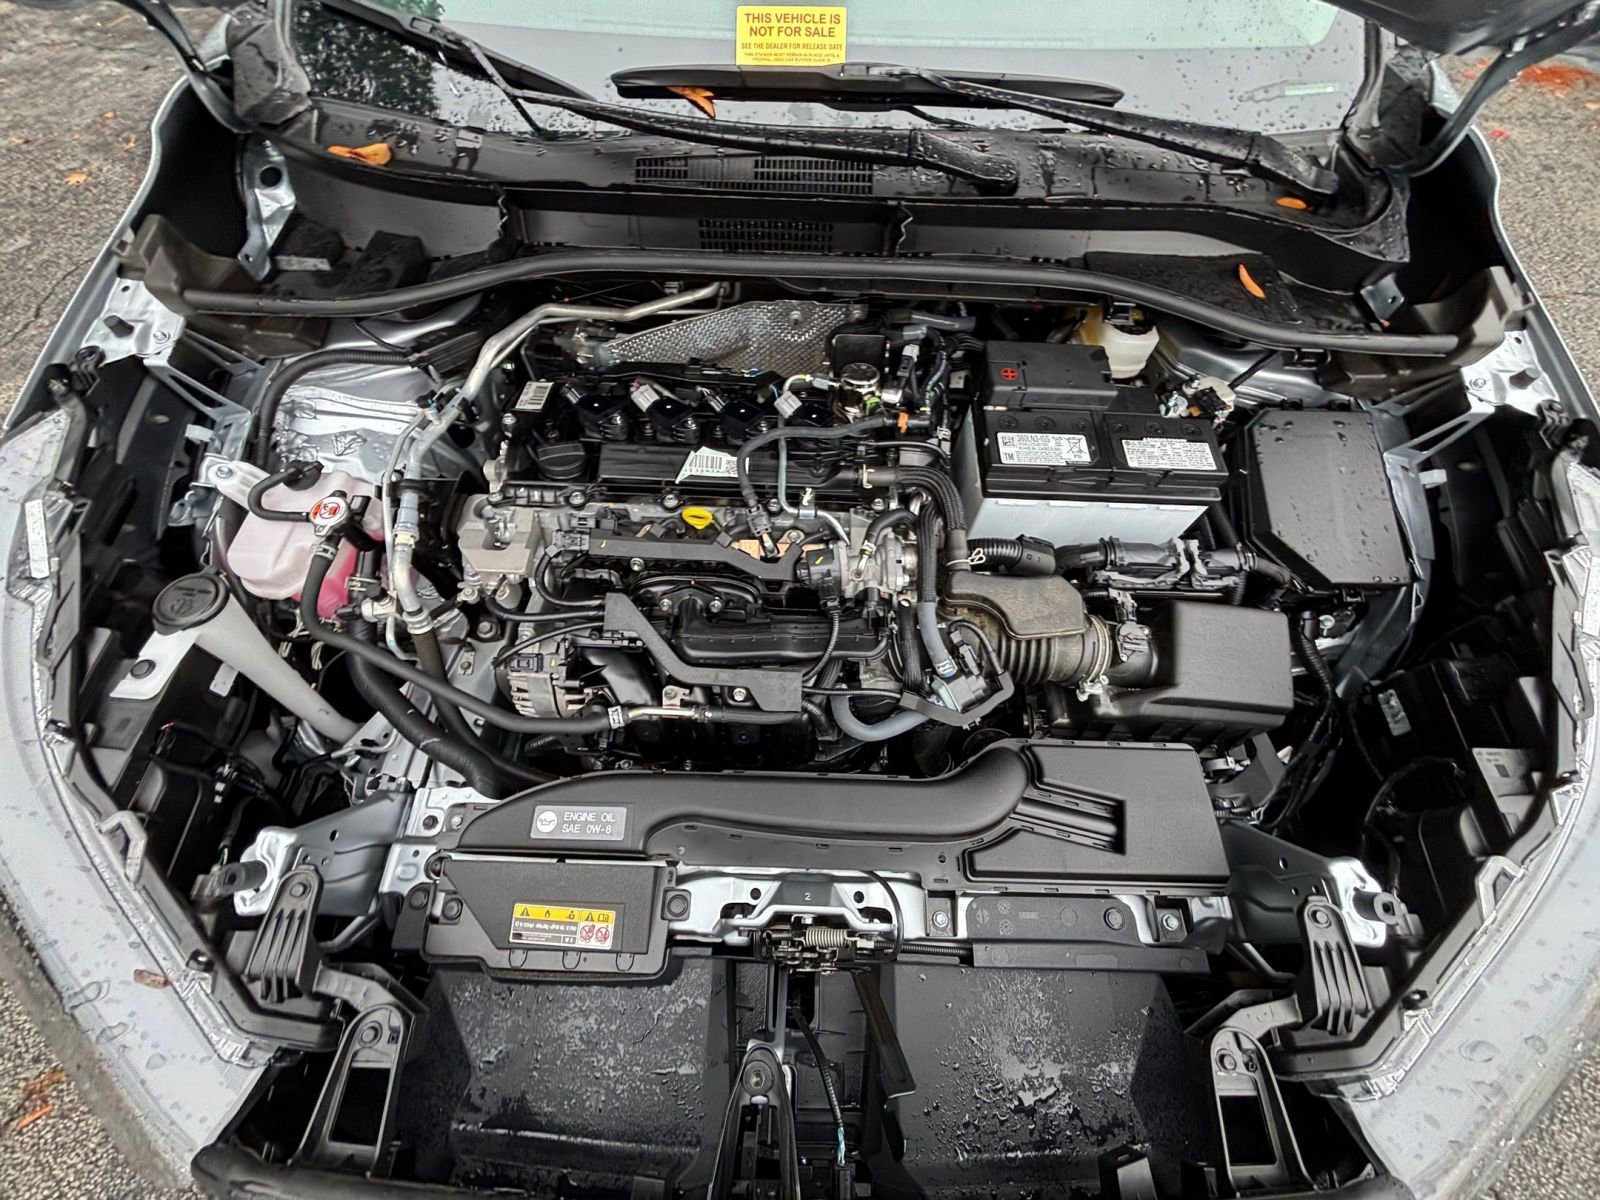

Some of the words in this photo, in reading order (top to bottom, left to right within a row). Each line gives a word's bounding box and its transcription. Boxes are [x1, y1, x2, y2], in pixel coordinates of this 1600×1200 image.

[744, 13, 772, 23] THIS
[775, 13, 827, 24] VEHICLE
[830, 14, 841, 24] IS
[749, 26, 774, 36] NOT
[777, 26, 801, 37] FOR
[804, 27, 836, 37] SALE
[563, 811, 597, 821] ENGINE
[601, 812, 616, 822] OIL
[561, 823, 581, 833] SAE
[586, 824, 612, 834] 0W-8
[804, 892, 812, 901] 2
